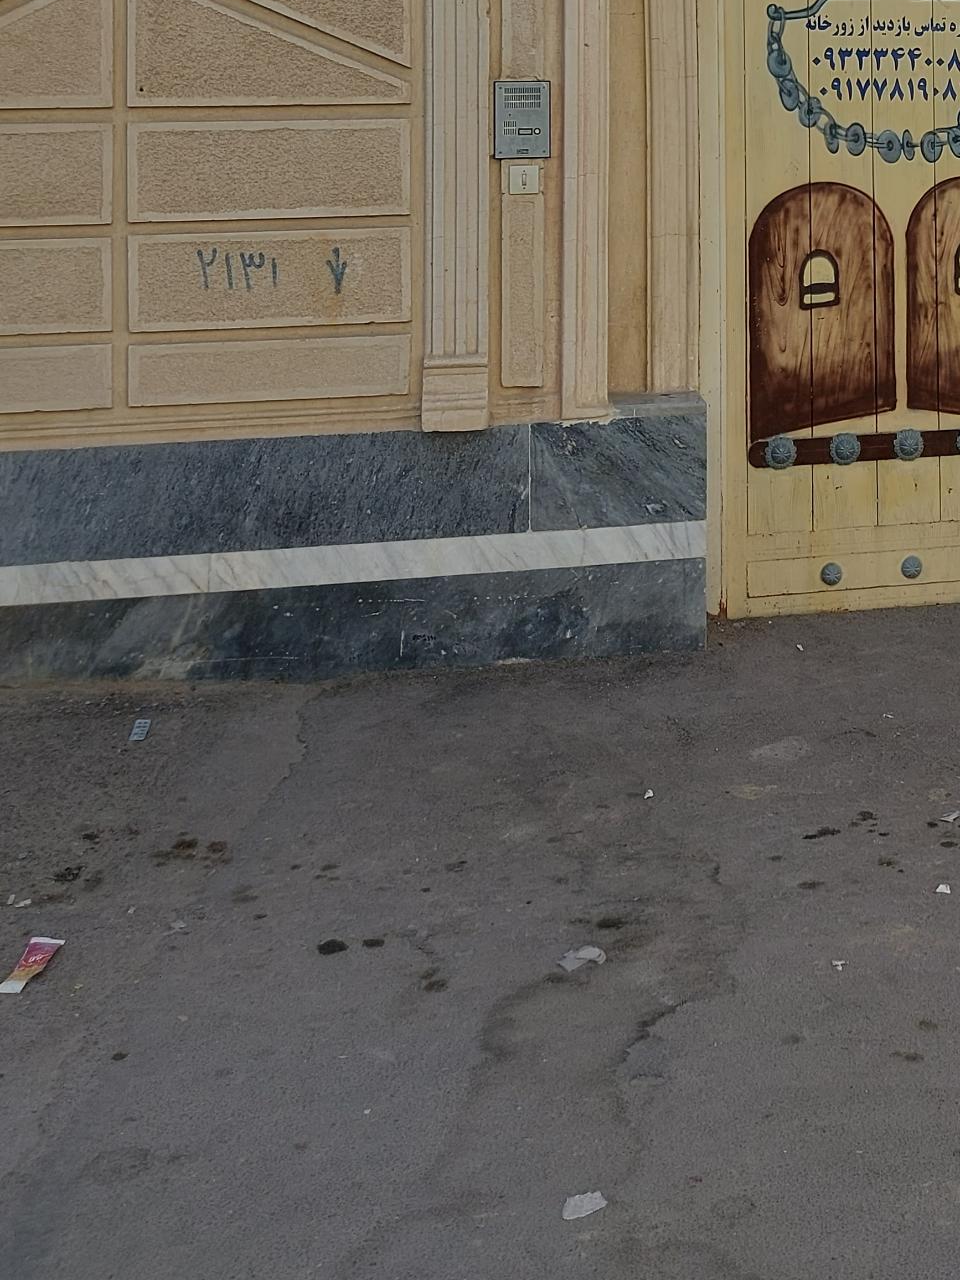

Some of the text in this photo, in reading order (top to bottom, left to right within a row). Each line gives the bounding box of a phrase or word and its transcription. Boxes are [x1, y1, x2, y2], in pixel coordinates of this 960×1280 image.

[857, 15, 869, 36] از
[872, 16, 911, 37] بازدید
[914, 16, 947, 37] تماس
